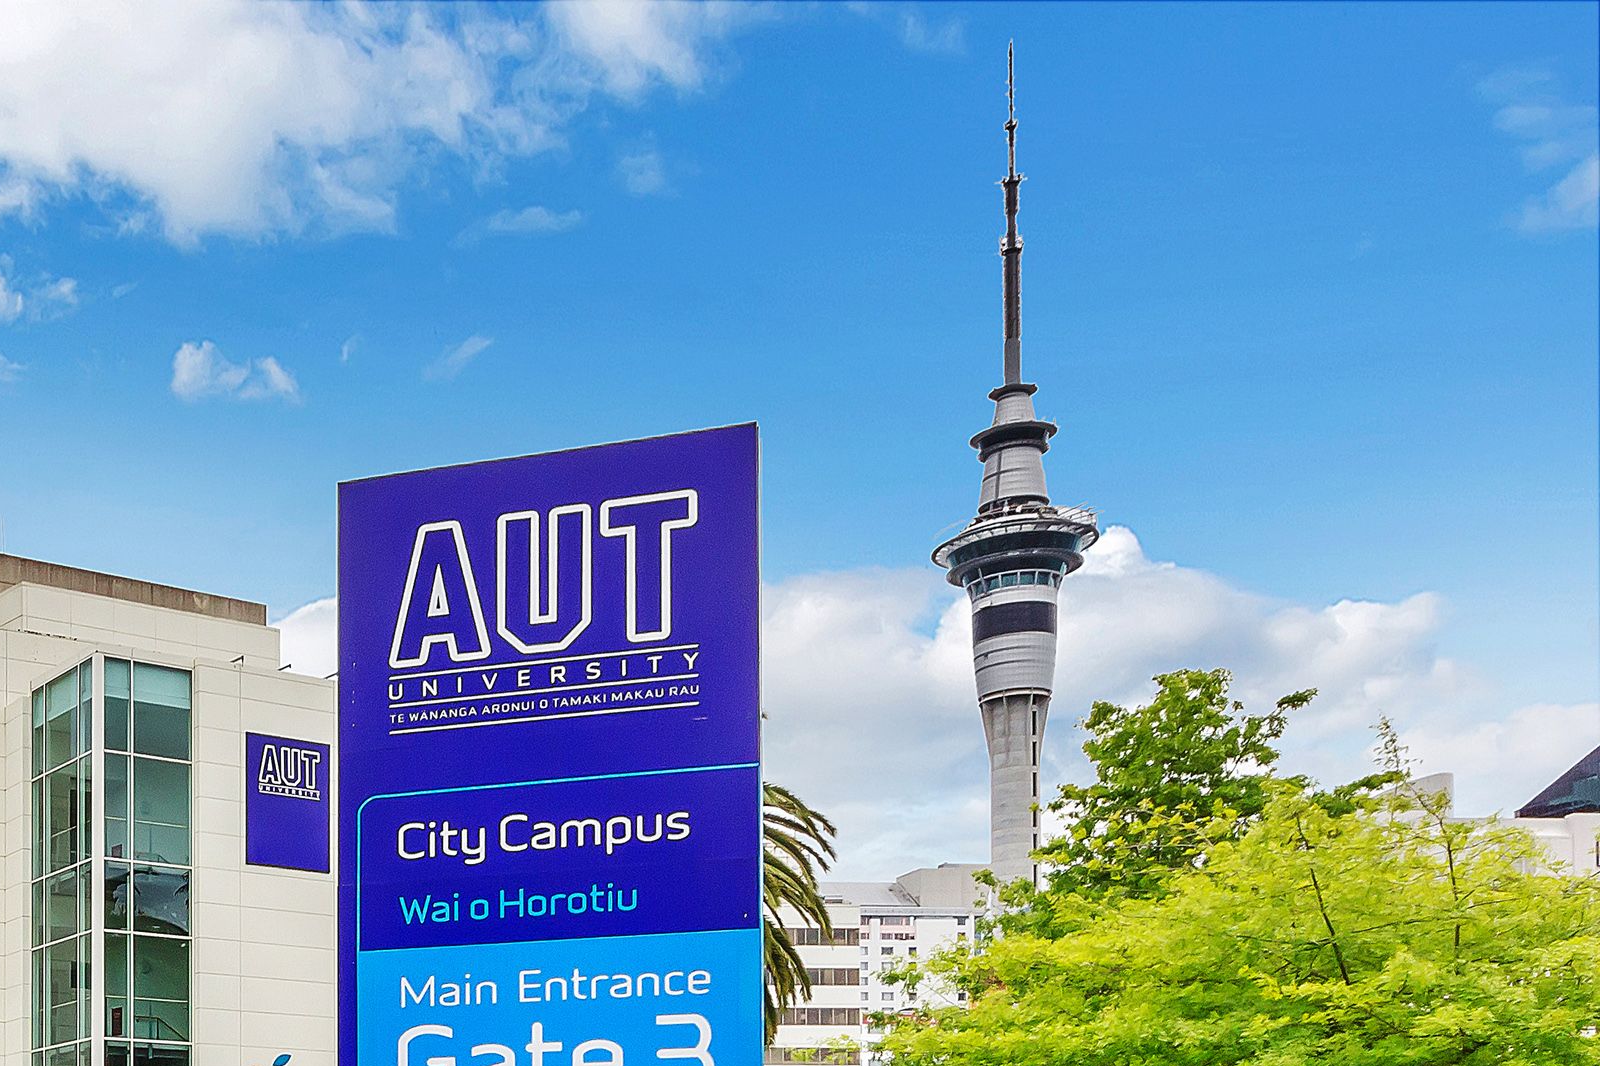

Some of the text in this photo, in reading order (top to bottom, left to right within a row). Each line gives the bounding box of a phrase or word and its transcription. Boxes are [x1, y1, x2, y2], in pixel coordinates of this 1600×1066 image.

[388, 488, 699, 670] AUT
[388, 652, 699, 701] UNIVERSITY
[389, 714, 405, 724] TE
[481, 702, 536, 716] ARONUI
[539, 699, 549, 710] O
[552, 696, 608, 709] TAMAKI
[611, 688, 666, 702] MAKAU
[669, 685, 700, 697] RAU
[258, 744, 321, 790] AUT
[398, 811, 690, 865] City Campus
[399, 882, 638, 925] Wai o Horotiu
[400, 968, 711, 1009] Main Entrance
